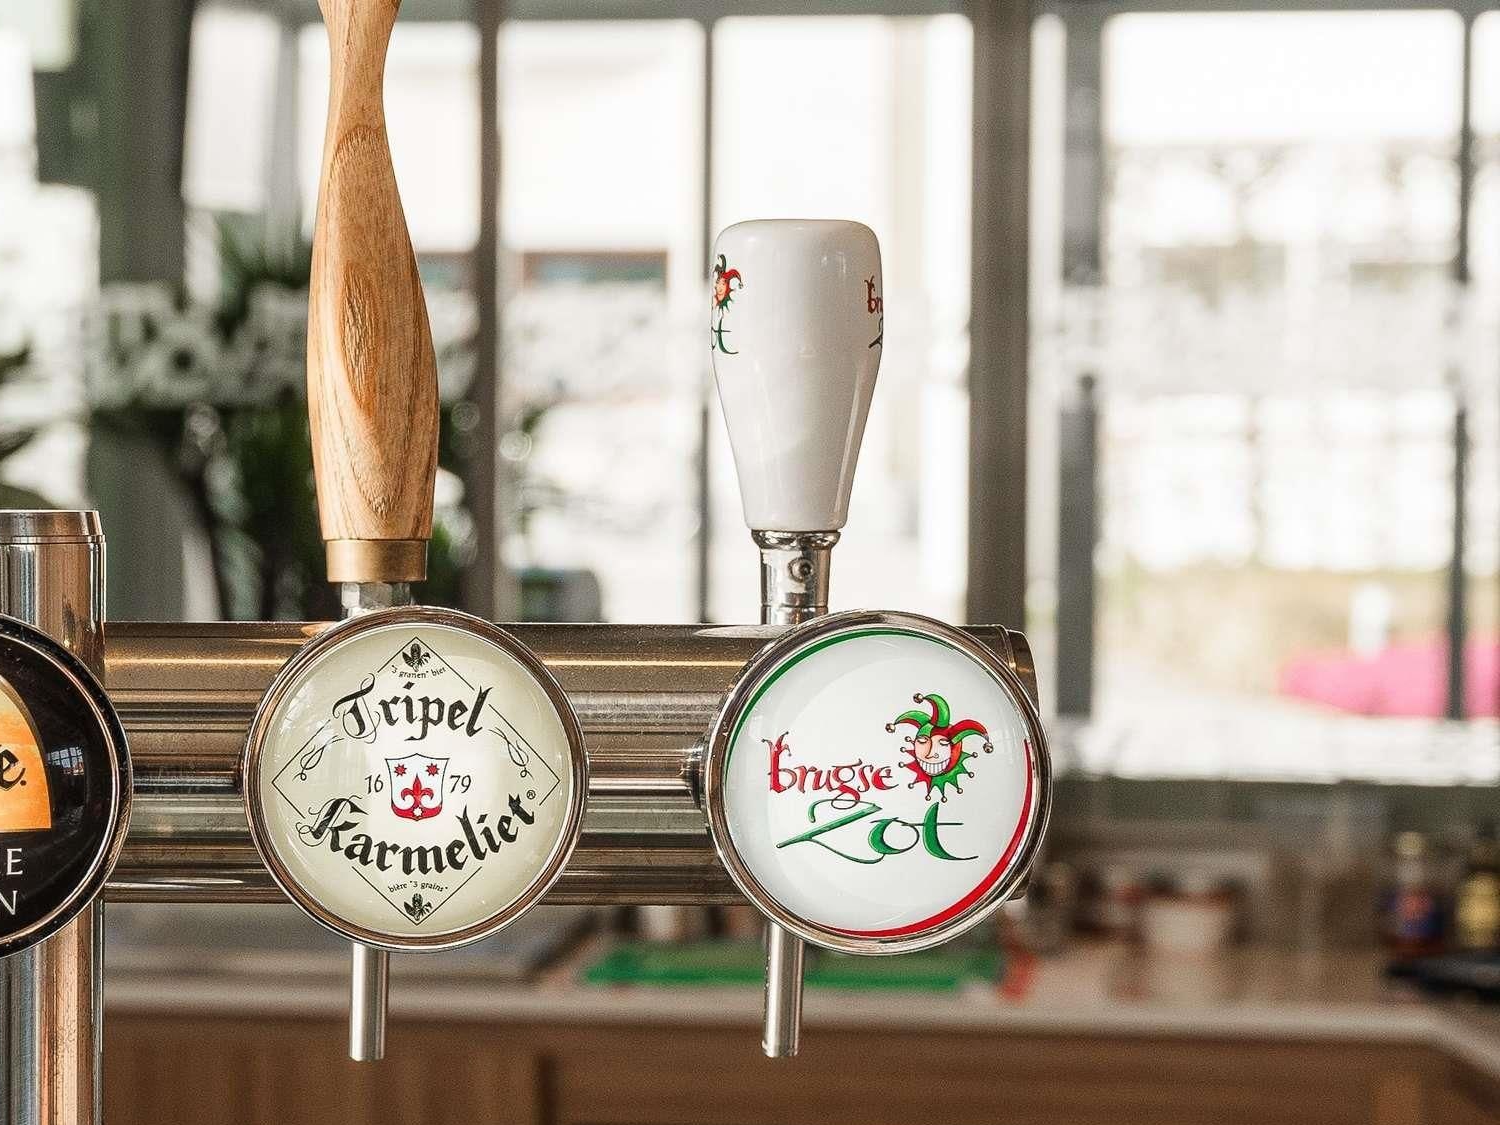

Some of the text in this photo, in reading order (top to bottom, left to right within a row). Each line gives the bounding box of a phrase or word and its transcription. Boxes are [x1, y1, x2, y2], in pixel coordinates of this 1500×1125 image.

[332, 672, 494, 744] Tripel
[364, 774, 472, 794] 16 79
[761, 731, 900, 811] brugse
[296, 793, 536, 876] Karmeliet
